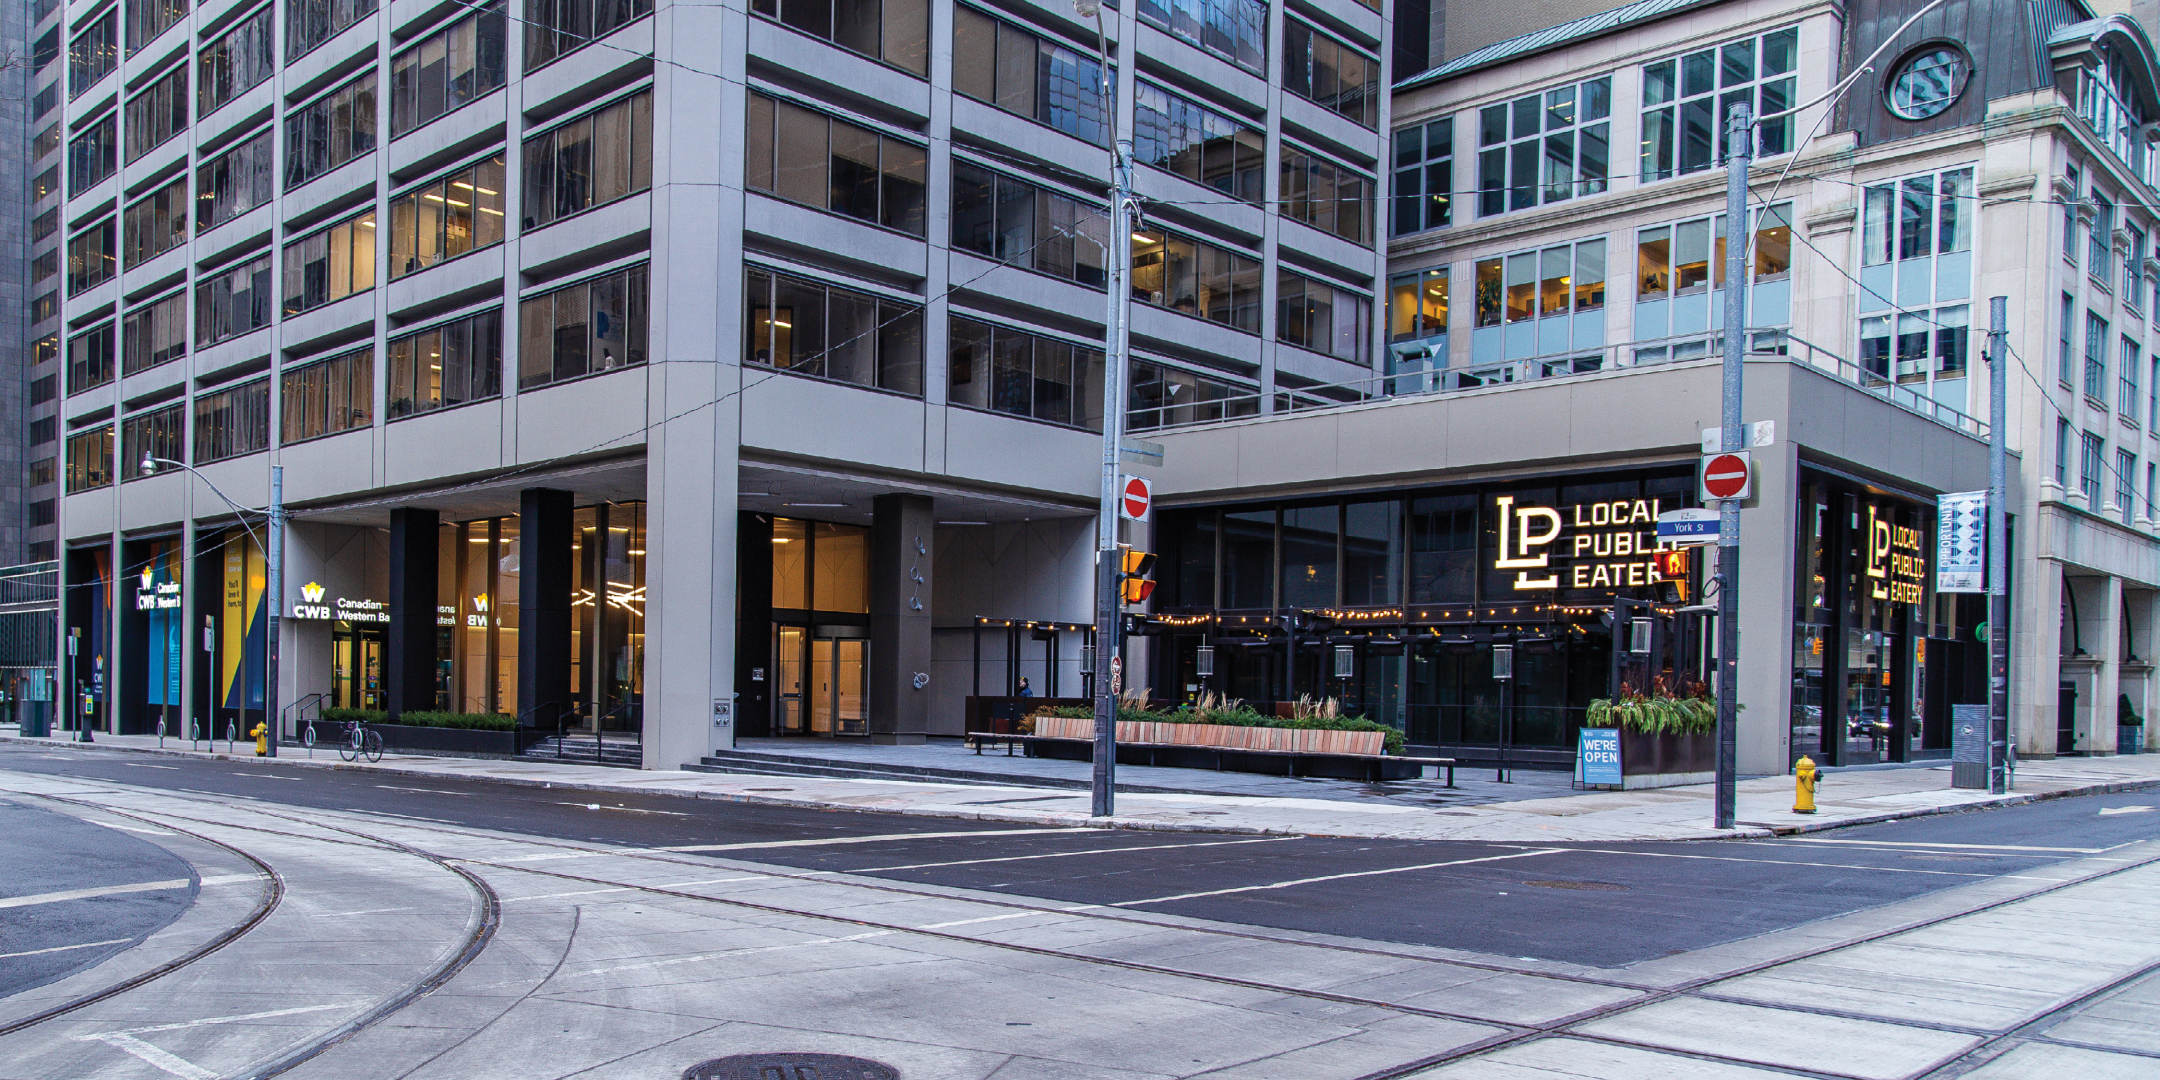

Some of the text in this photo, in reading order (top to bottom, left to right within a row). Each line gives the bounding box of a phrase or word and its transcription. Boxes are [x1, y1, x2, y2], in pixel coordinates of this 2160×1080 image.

[1575, 499, 1659, 527] LOCAL
[1674, 523, 1704, 532] York St
[1940, 497, 1951, 568] OPPORTUNITY
[1892, 524, 1920, 551] LOCAL
[1892, 552, 1925, 578] PUBLIC
[1573, 562, 1661, 588] EATER
[1891, 580, 1924, 605] EATERY
[139, 595, 154, 609] CWB
[337, 598, 382, 609] Canadian
[293, 604, 331, 619] CWB
[337, 610, 390, 621] Western Ba
[94, 673, 103, 683] CW
[1584, 739, 1617, 750] WE'RE
[1585, 751, 1618, 763] OPEN
